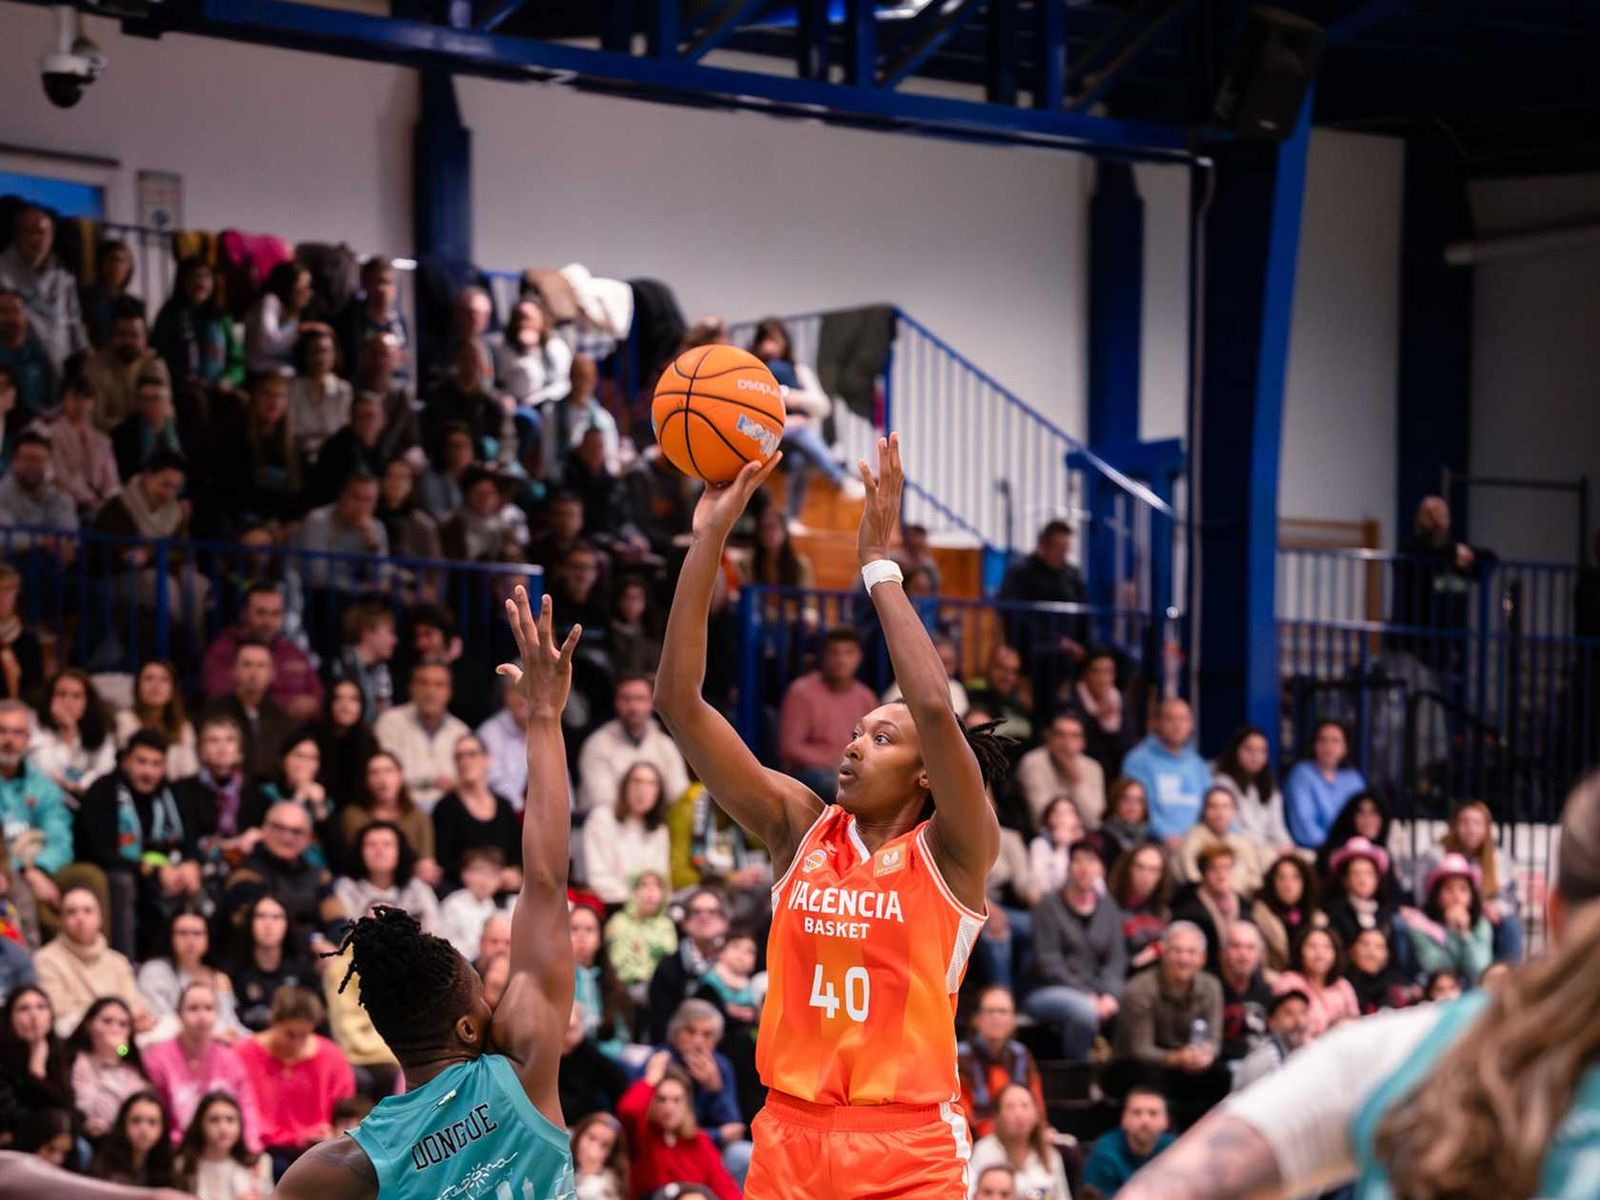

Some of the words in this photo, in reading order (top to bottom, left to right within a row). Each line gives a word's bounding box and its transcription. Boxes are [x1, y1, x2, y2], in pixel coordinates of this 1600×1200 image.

[804, 917, 870, 939] BASKET
[809, 964, 870, 1022] 40
[410, 1102, 498, 1172] DONGUE
